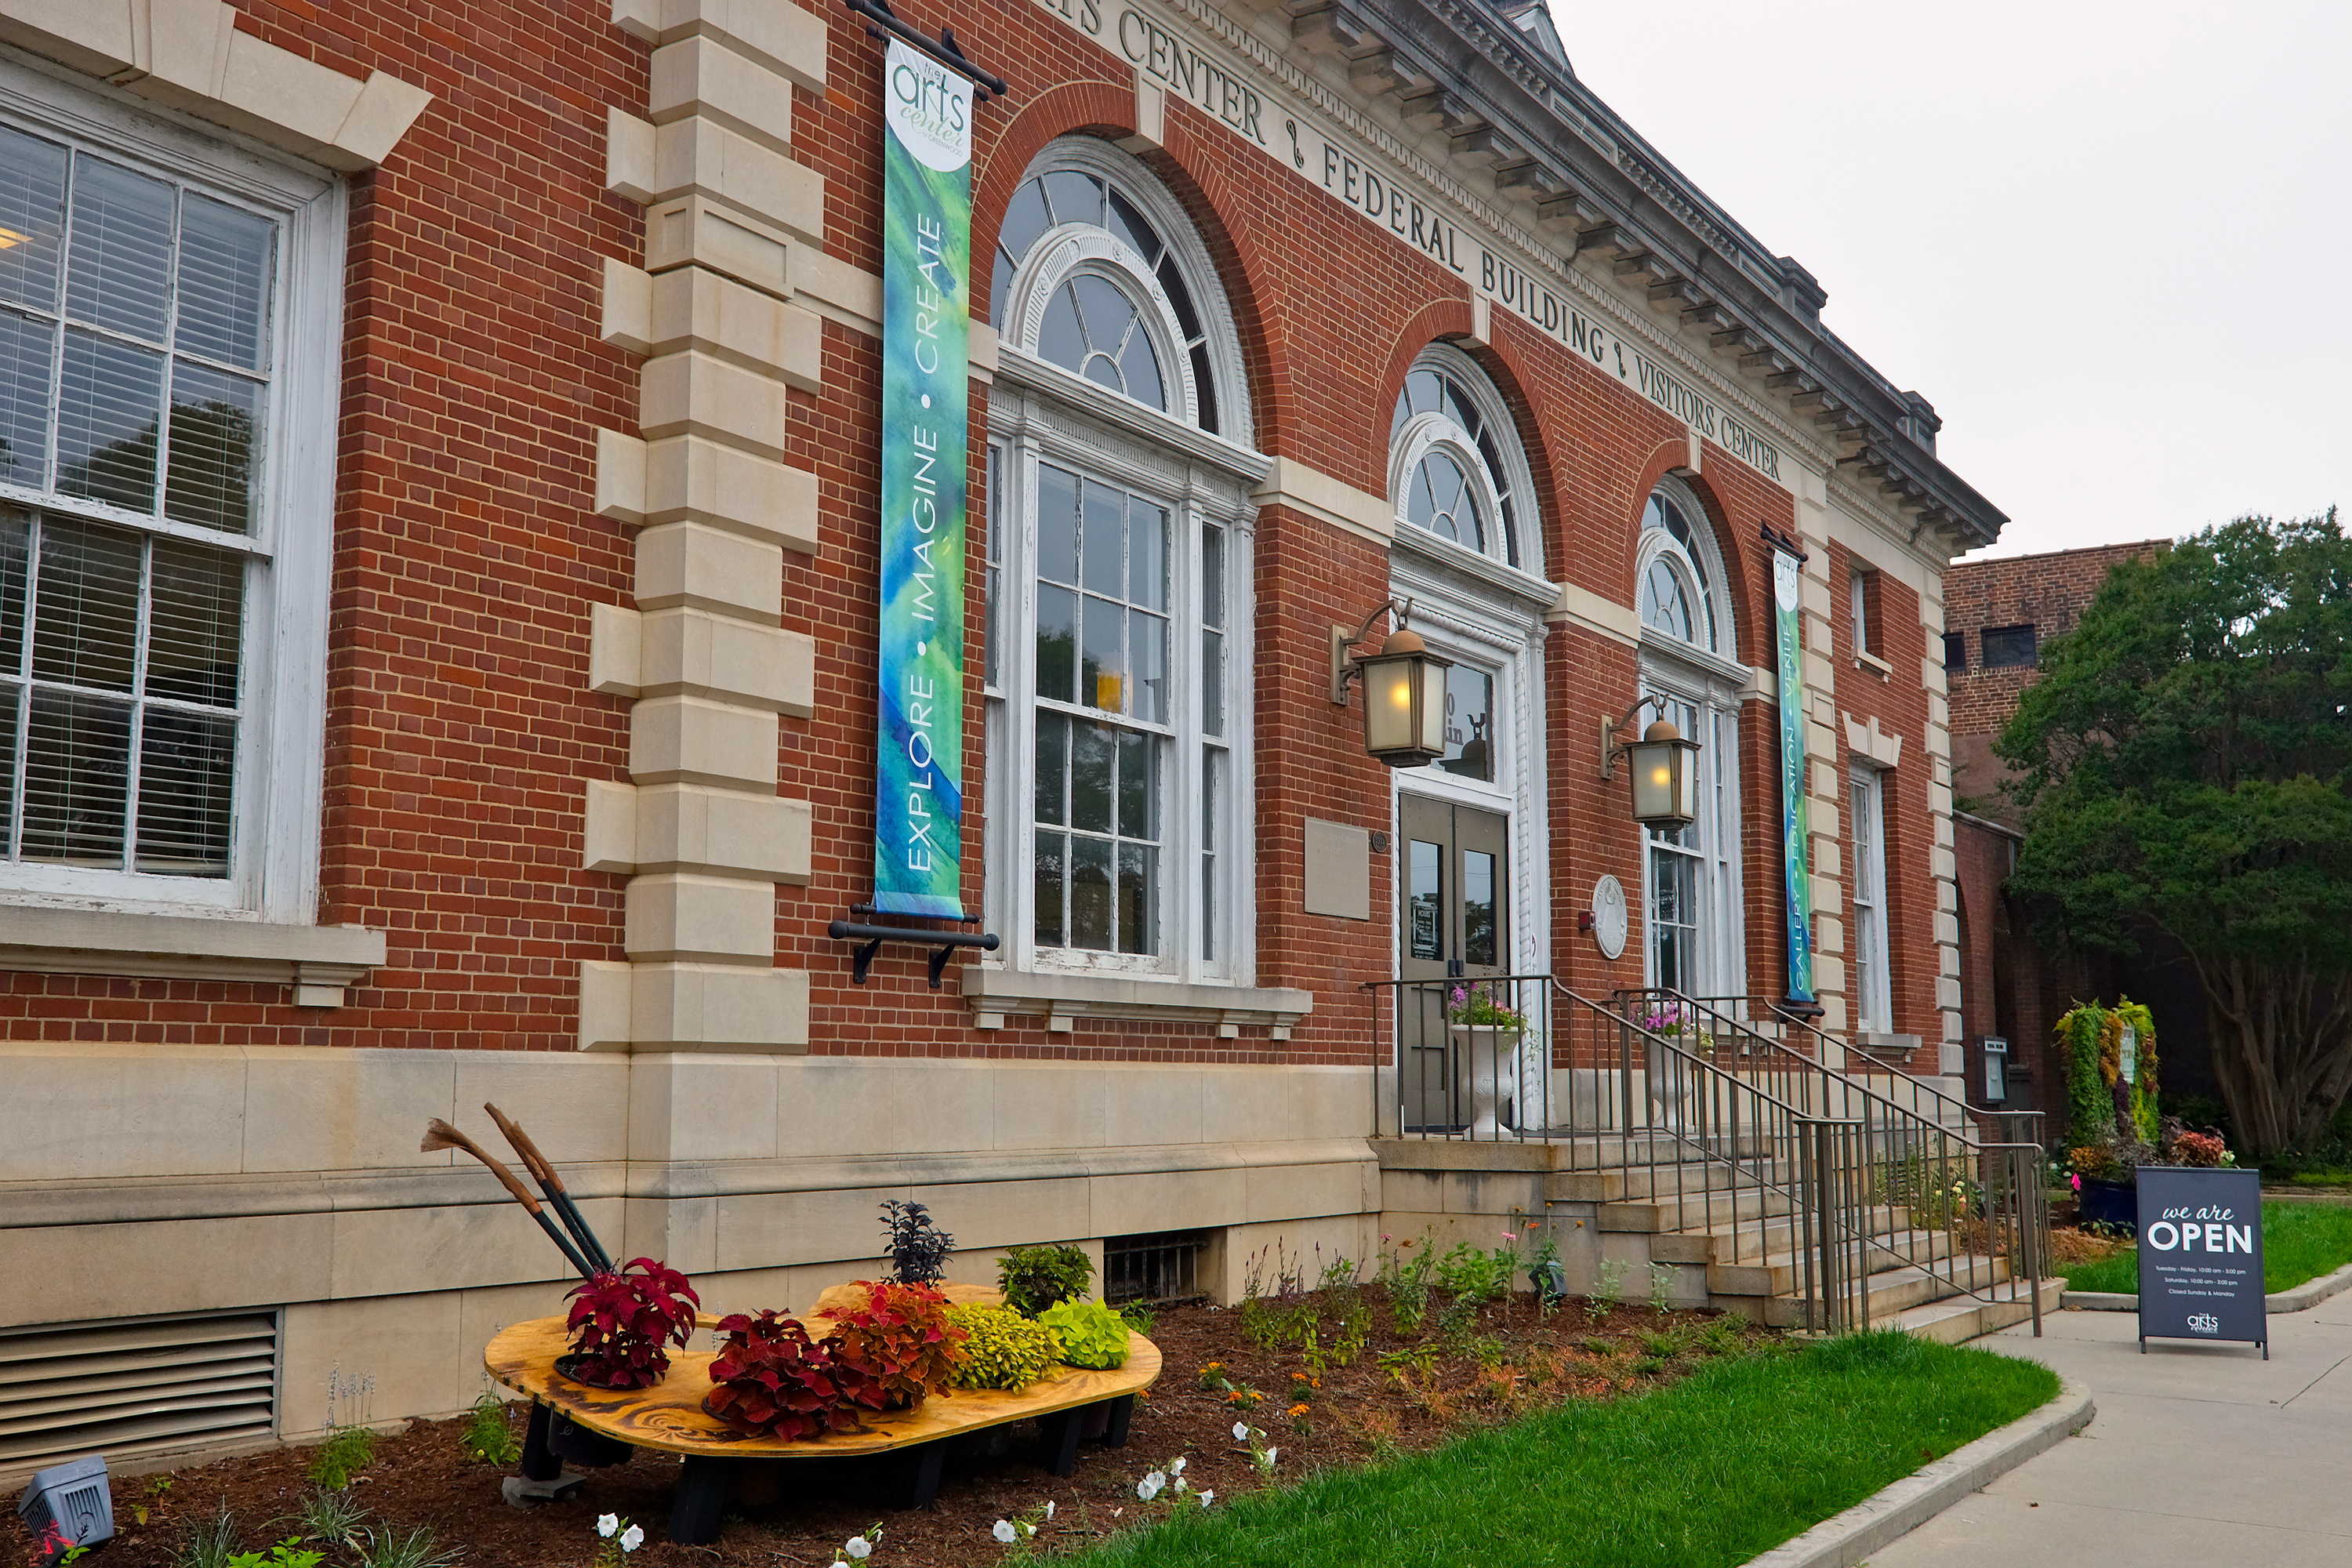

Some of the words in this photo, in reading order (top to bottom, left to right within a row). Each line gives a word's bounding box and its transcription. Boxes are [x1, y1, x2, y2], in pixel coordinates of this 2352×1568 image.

[893, 64, 964, 132] arts
[924, 62, 941, 80] the
[900, 106, 964, 147] center
[927, 134, 964, 158] GREENWOOD
[1119, 9, 1267, 146] CENTER
[1323, 143, 1465, 274] FEDERAL
[1481, 249, 1605, 364] BUILDING
[1635, 354, 1715, 438] VISITORS
[1721, 416, 1781, 482] CENTER
[914, 212, 941, 375] CREATE
[911, 424, 938, 622] IMAGINE
[1775, 559, 1796, 589] arts
[908, 673, 934, 872] EXPLORE
[1786, 726, 1798, 860] EDUCATION
[1792, 893, 1805, 991] GALLERY
[2147, 1221, 2252, 1254] OPEN
[2161, 1207, 2192, 1219] we
[2196, 1204, 2234, 1221] are
[2187, 1312, 2219, 1328] arts
